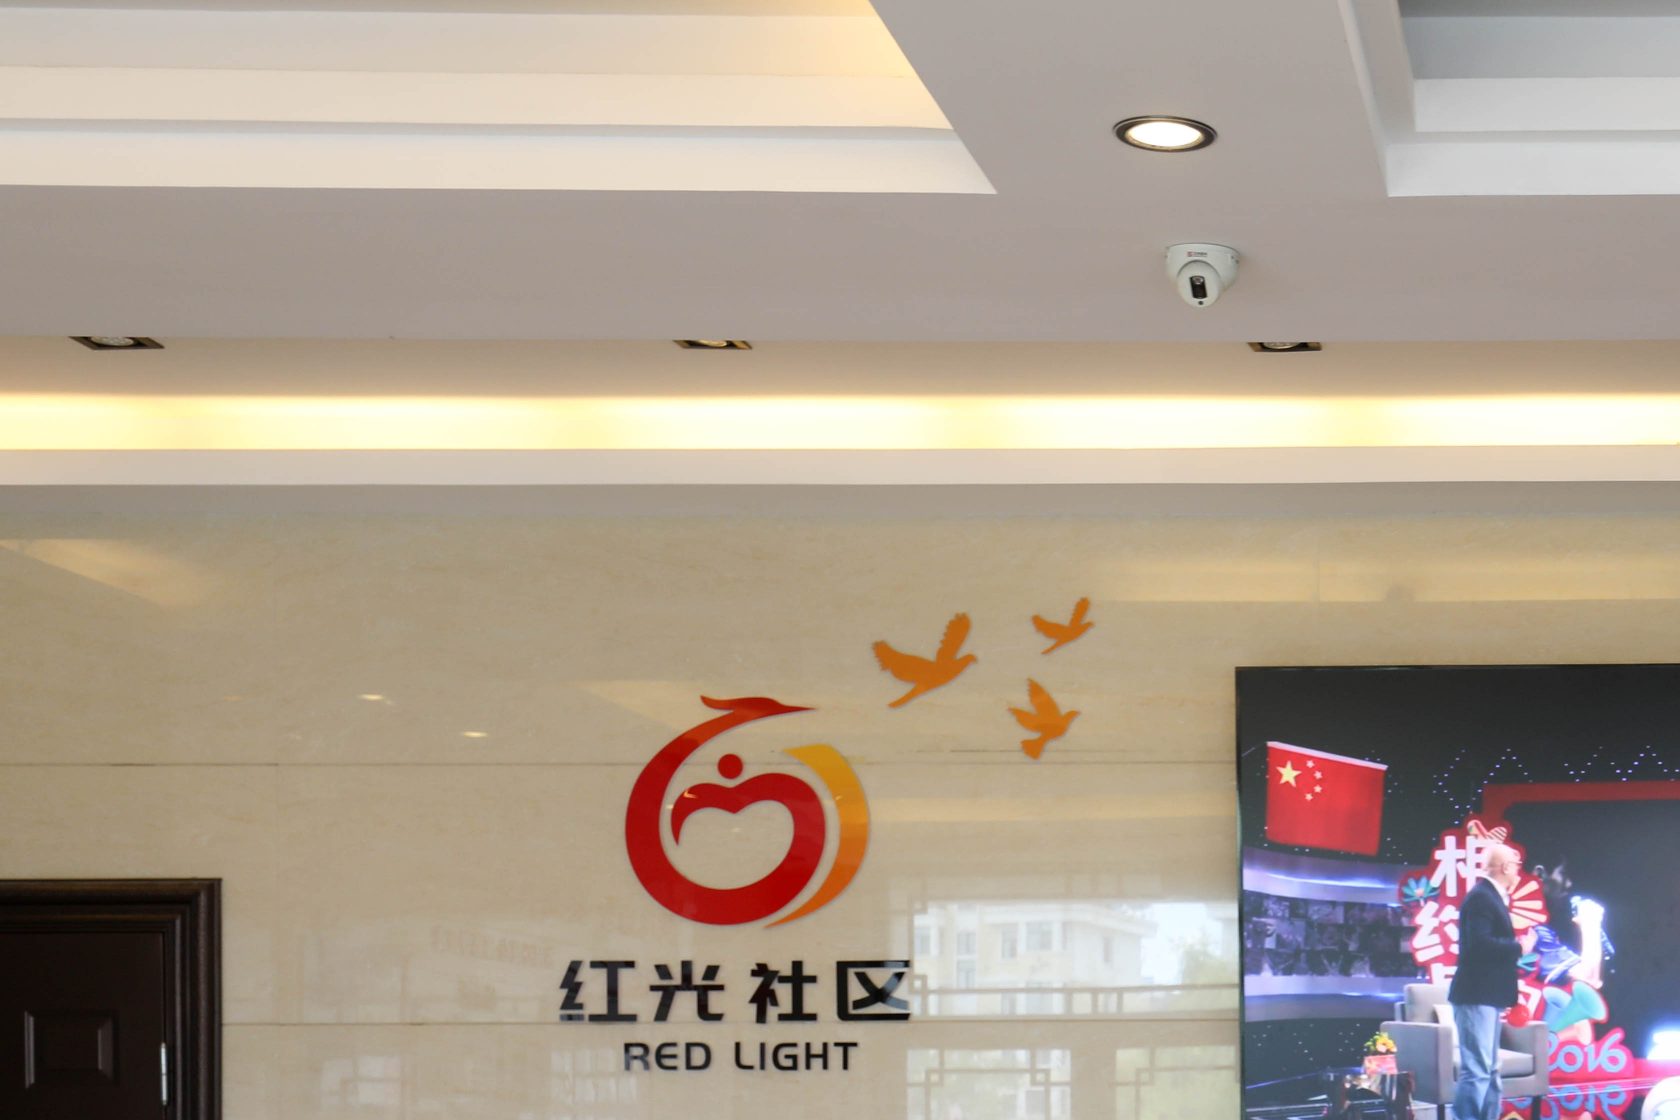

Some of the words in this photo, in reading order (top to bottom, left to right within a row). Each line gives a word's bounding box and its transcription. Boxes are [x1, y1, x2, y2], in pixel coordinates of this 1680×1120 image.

[559, 959, 912, 1024] 红光社区
[623, 1042, 712, 1071] RED
[734, 1041, 858, 1071] LIGHT
